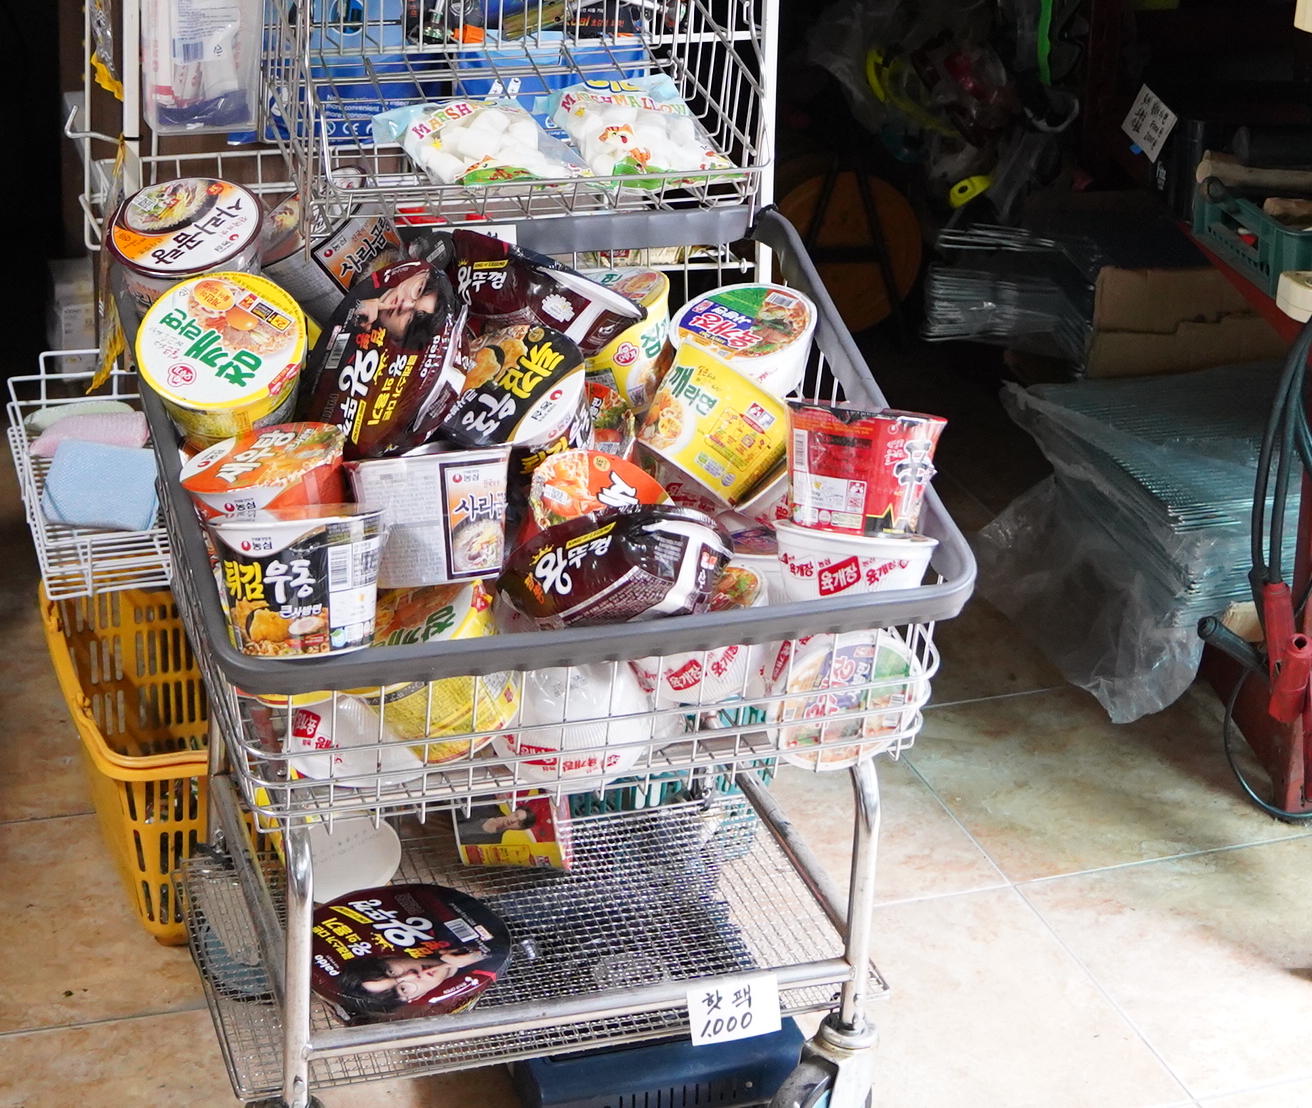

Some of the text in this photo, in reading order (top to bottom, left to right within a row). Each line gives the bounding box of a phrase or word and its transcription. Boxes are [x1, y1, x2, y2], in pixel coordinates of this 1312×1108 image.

[149, 197, 244, 265] 사리곰탕
[456, 266, 508, 307] 왕뚜껑
[159, 307, 263, 388] 참깨라면
[213, 430, 293, 485] 새우탕
[462, 472, 481, 483] 농심
[236, 500, 257, 511] 농심
[252, 539, 273, 551] 농심
[534, 534, 614, 596] 왕뚜껑
[224, 558, 317, 604] 튀김우동
[819, 560, 862, 593] 육개장
[669, 662, 703, 691] 육개장
[347, 898, 435, 948] 왕뚜껑
[314, 953, 341, 979] paldo
